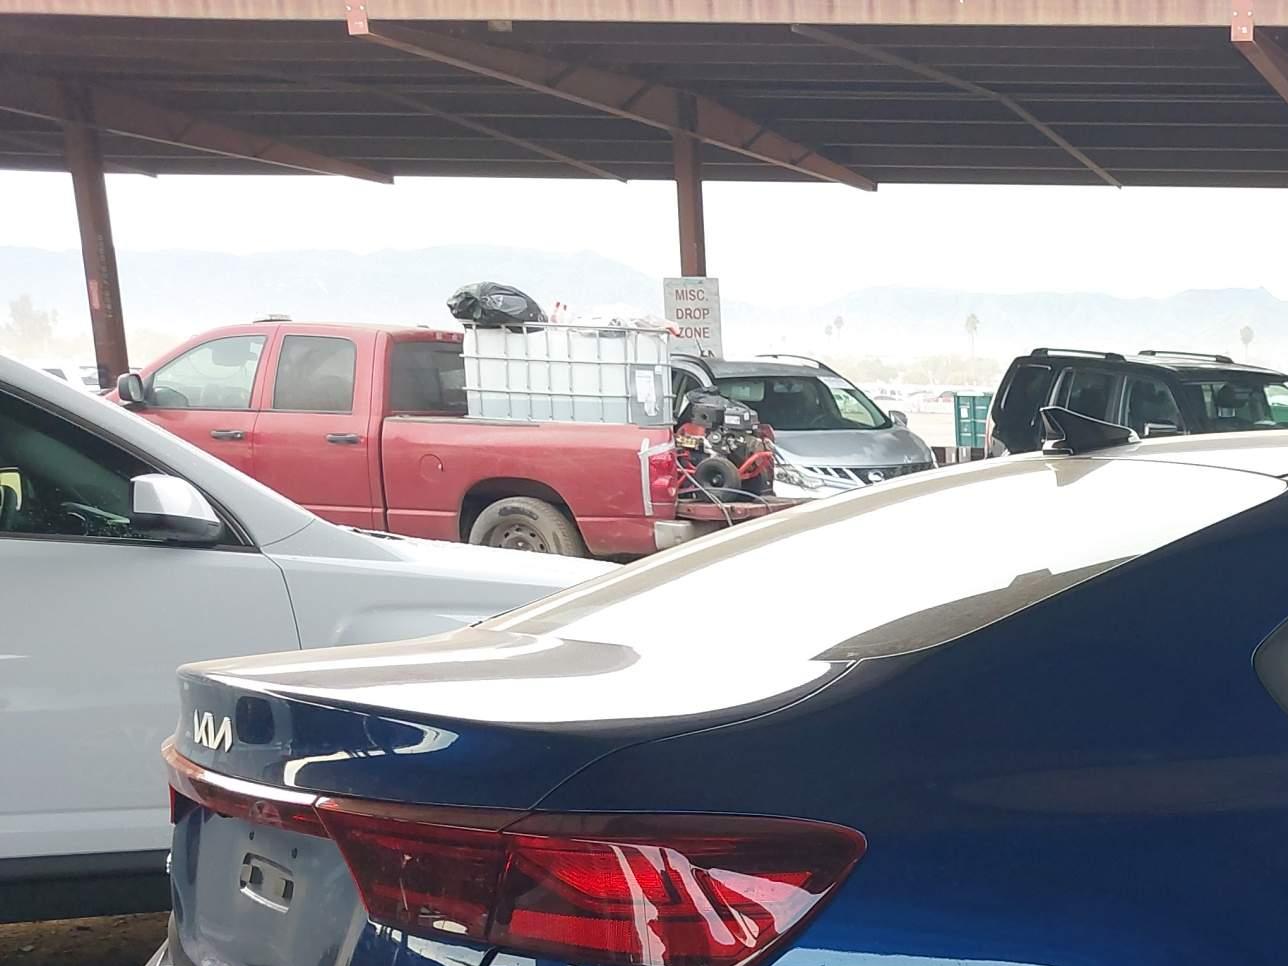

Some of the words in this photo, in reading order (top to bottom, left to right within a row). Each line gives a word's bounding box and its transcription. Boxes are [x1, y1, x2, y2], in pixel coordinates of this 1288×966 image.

[675, 289, 709, 302] MISC.
[675, 308, 710, 320] DROP
[679, 326, 710, 339] ZONE
